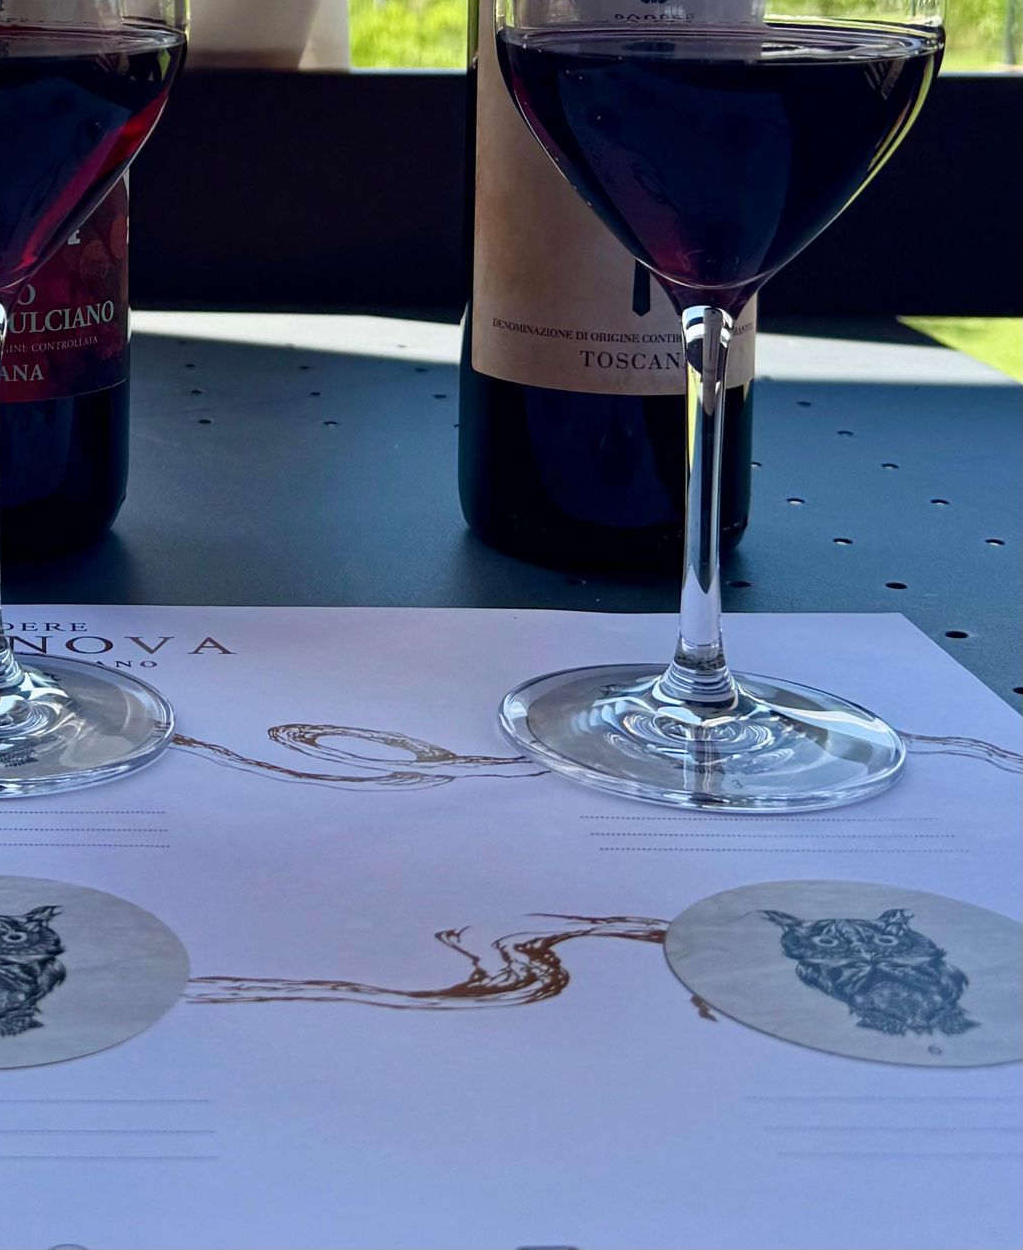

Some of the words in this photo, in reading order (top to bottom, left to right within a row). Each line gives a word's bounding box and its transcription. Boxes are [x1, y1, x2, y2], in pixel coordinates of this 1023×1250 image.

[576, 330, 588, 341] DI
[591, 332, 640, 344] ORIGINE
[579, 350, 686, 370] TOSCAN
